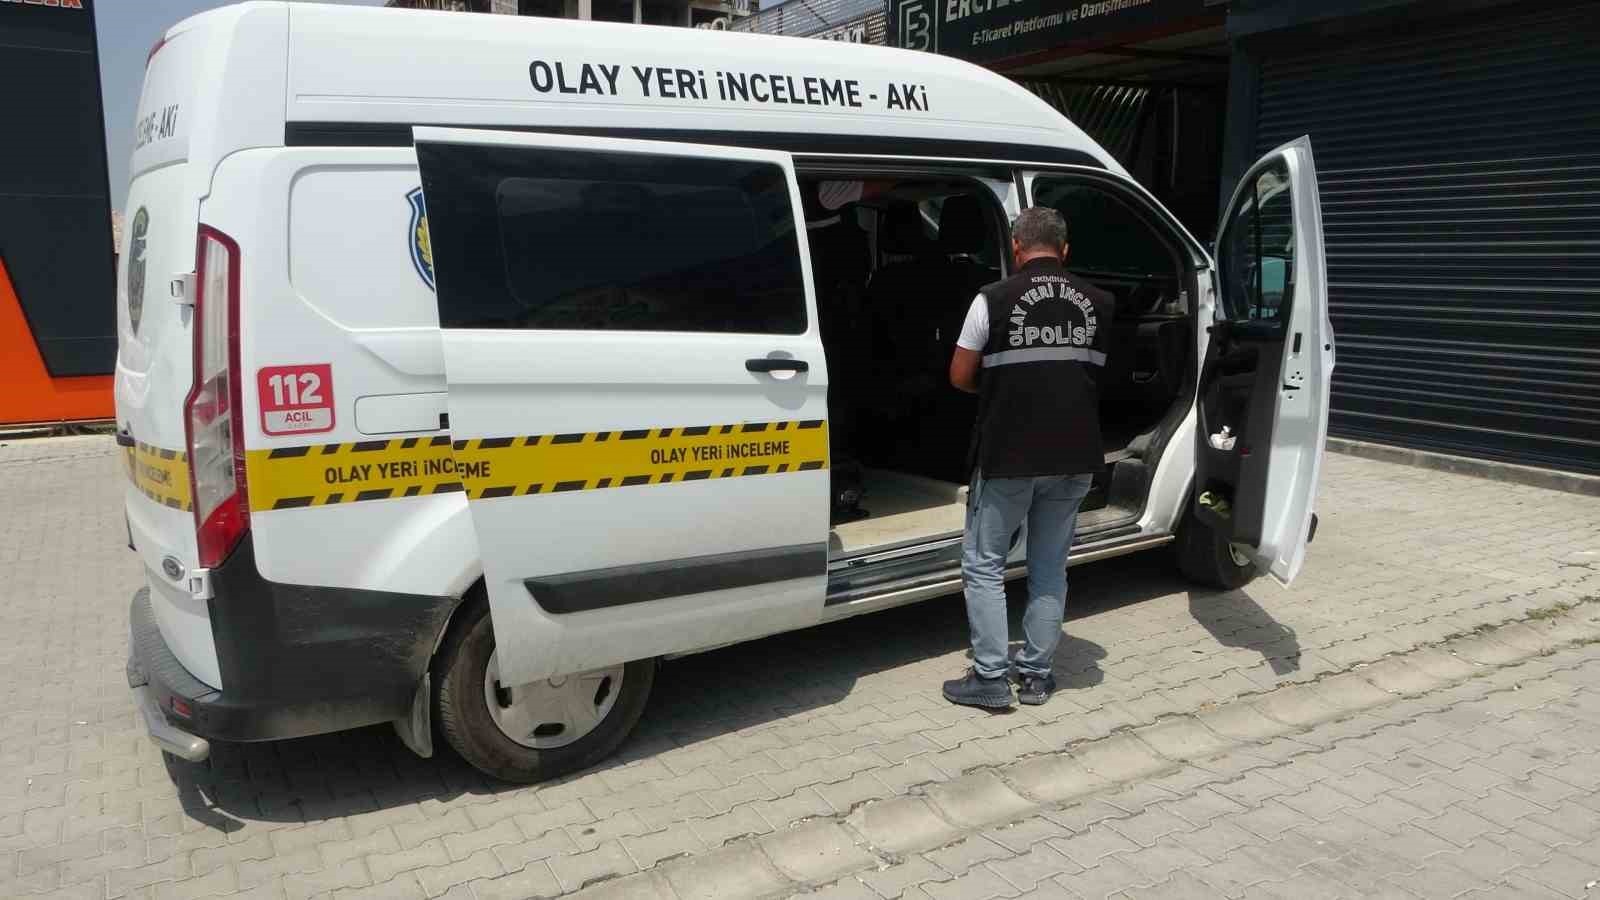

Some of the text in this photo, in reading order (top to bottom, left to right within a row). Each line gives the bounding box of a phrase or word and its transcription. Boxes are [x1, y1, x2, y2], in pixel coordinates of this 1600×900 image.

[1013, 13, 1064, 35] Platformu
[1065, 9, 1079, 22] ve
[528, 60, 620, 95] OLAY
[1008, 303, 1028, 346] OLAY
[268, 372, 323, 406] 112
[650, 448, 687, 464] OLAY
[325, 465, 371, 484] OLAY
